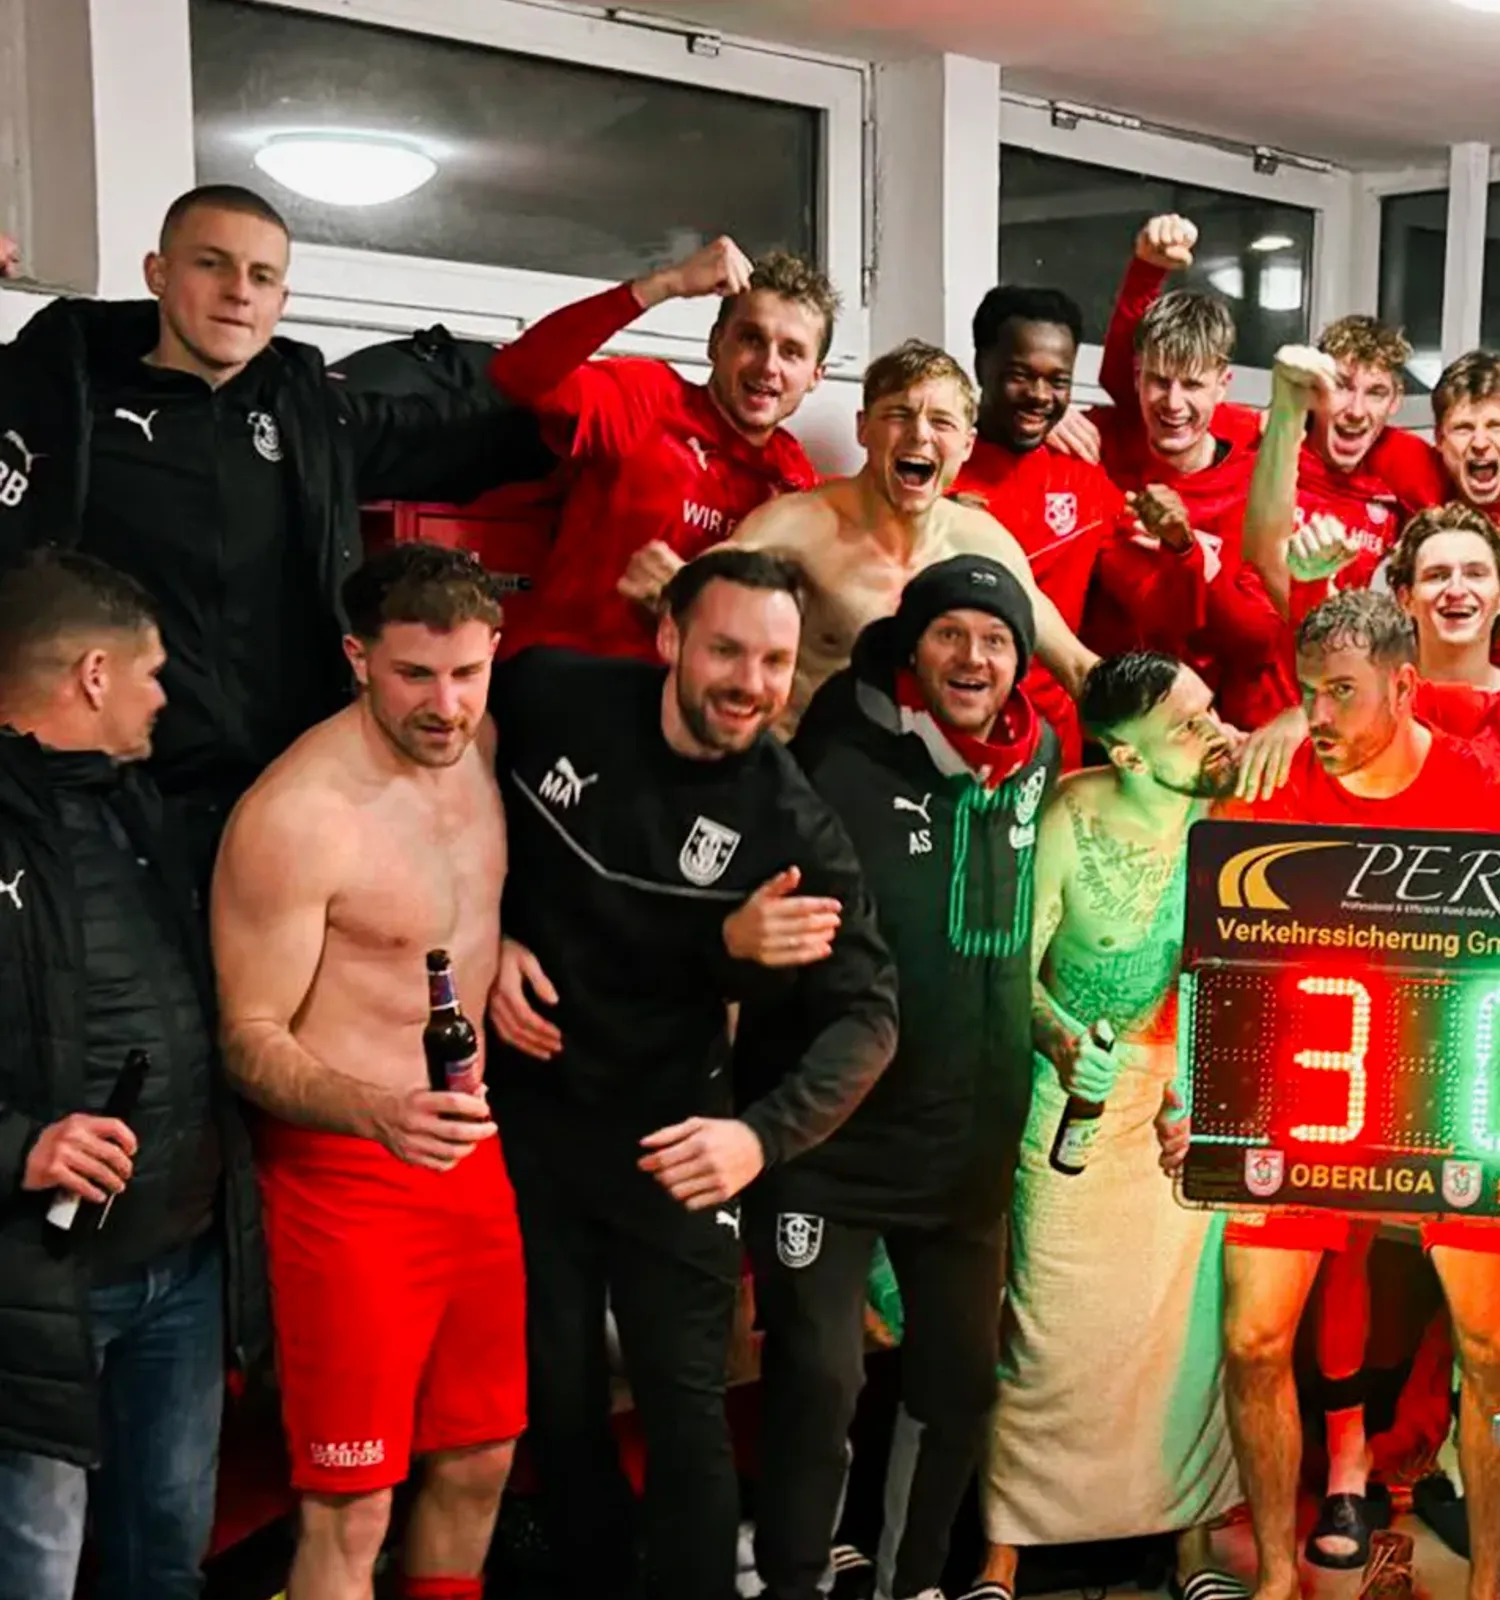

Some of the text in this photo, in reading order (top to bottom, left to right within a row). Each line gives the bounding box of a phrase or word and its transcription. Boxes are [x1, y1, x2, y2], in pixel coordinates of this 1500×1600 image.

[684, 500, 723, 533] WIR
[909, 829, 933, 855] AS
[1217, 917, 1460, 958] Verkehrssicherung
[1289, 975, 1372, 1144] 3
[1290, 1163, 1435, 1194] OBERLIGA
